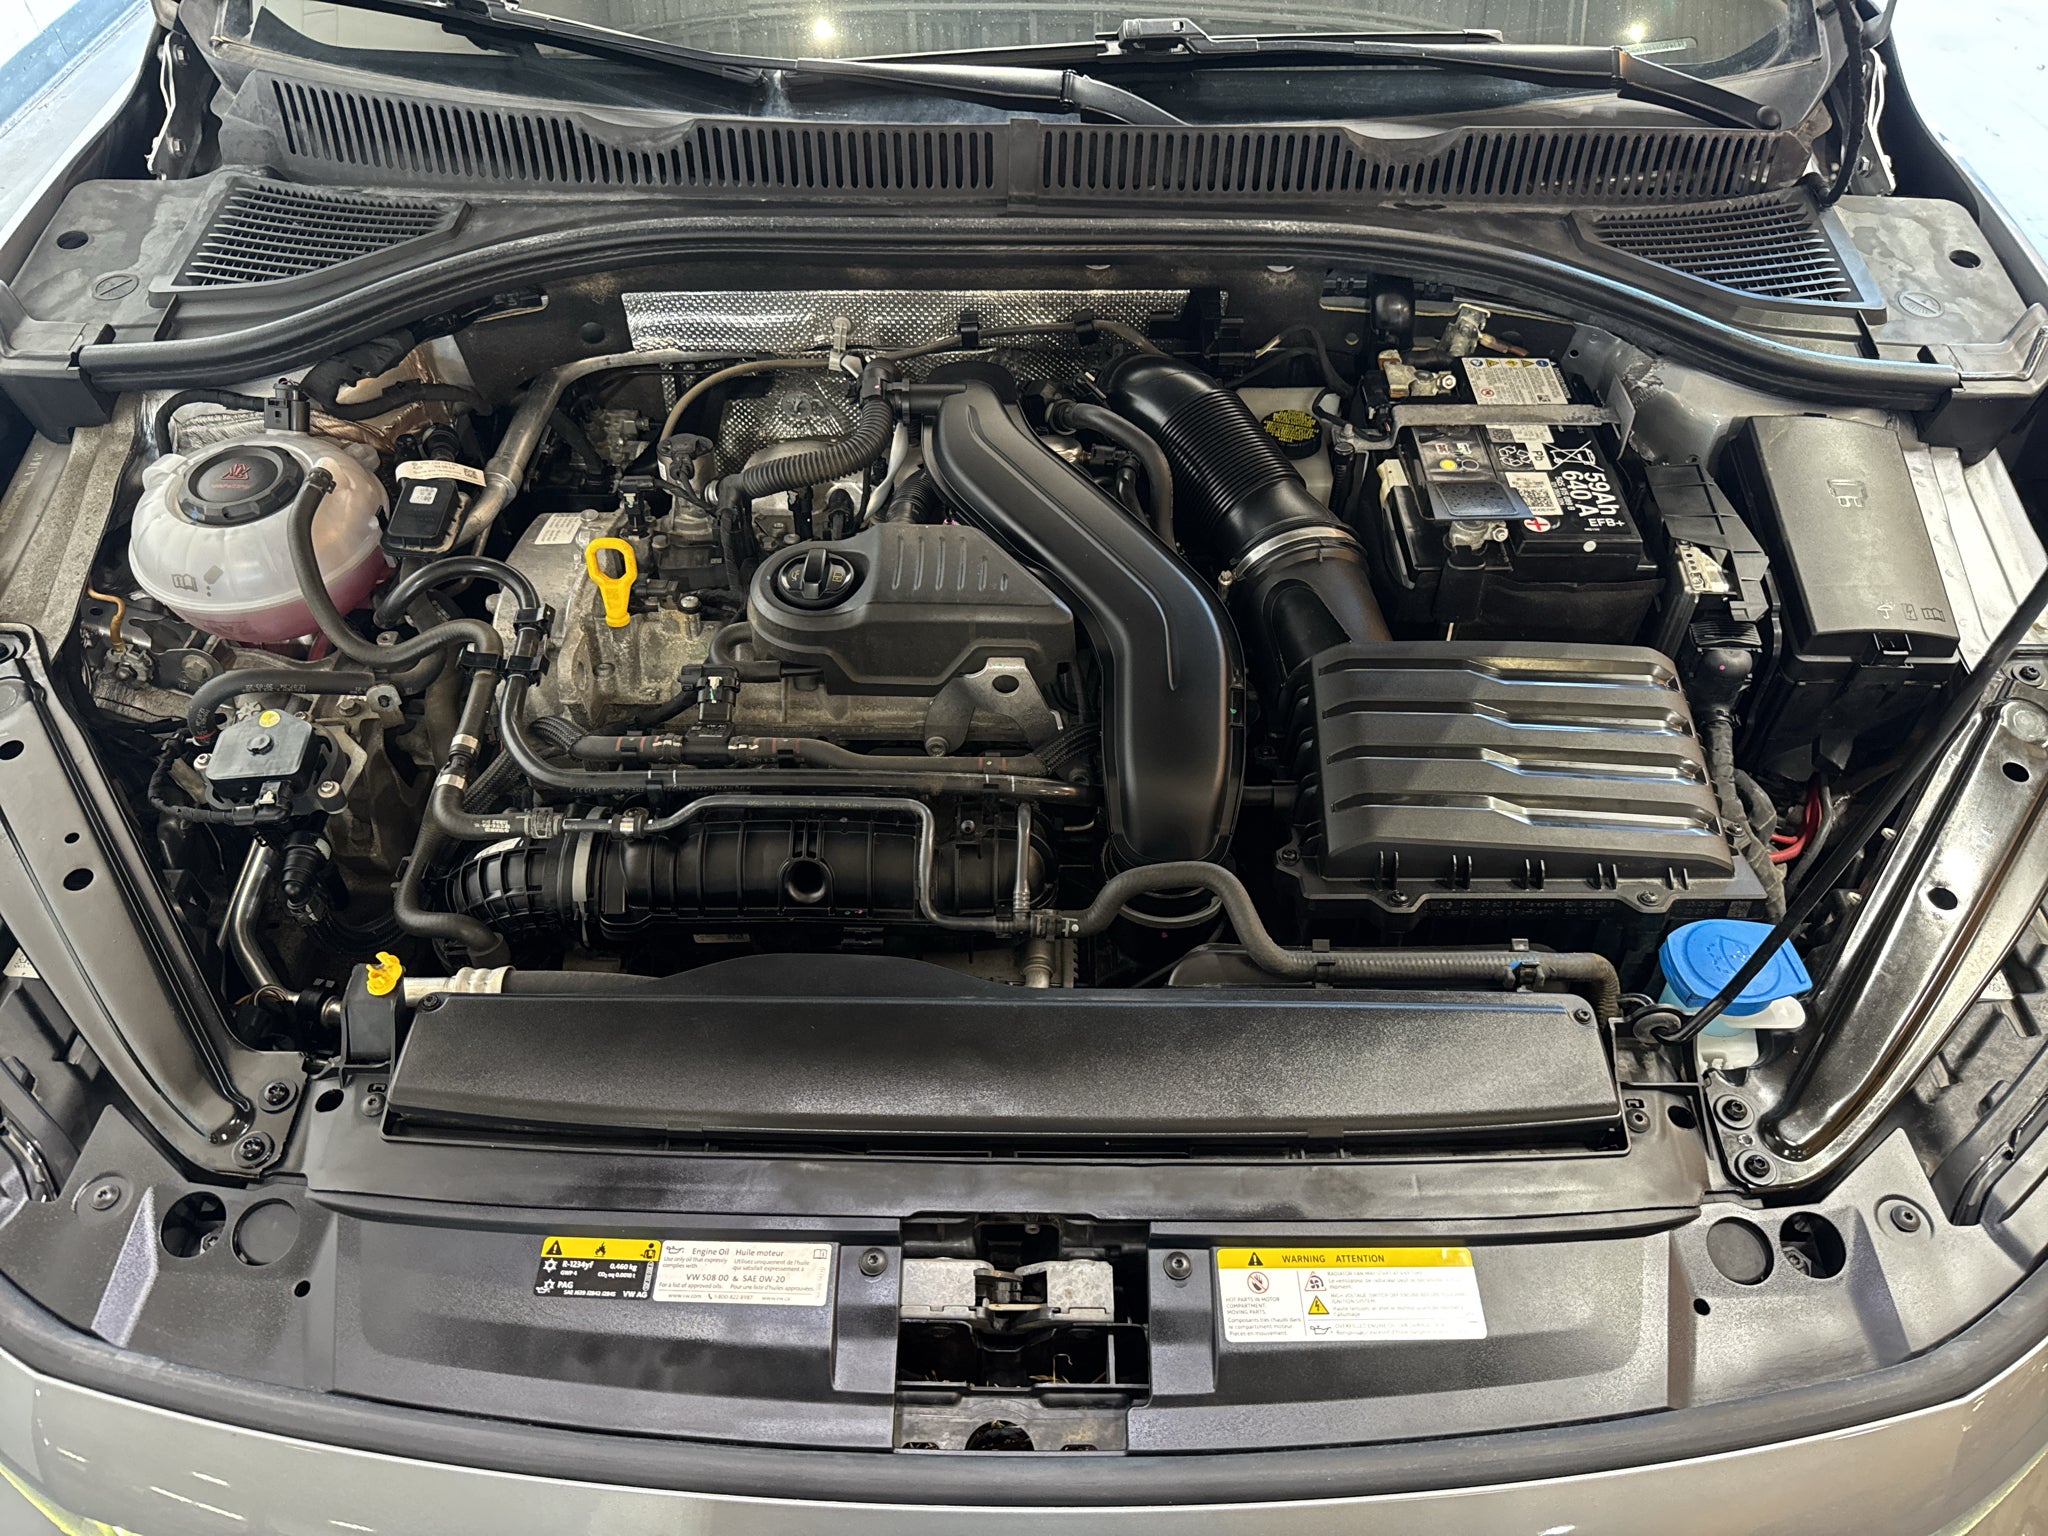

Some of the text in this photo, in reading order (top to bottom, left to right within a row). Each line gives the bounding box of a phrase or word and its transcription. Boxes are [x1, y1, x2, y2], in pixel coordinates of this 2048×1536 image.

[1562, 470, 1593, 500] 640
[1584, 472, 1620, 515] 59Ah
[1575, 503, 1600, 517] A
[1588, 518, 1625, 527] EFB+
[692, 1248, 718, 1257] Engine
[735, 1248, 784, 1257] Huile moteur
[1281, 1254, 1326, 1263] WARNING
[1336, 1254, 1385, 1263] ATTENTION
[562, 1260, 594, 1270] R-1234yf
[629, 1263, 637, 1271] kg
[758, 1275, 786, 1283] 0W-20
[557, 1280, 574, 1288] PAG
[687, 1282, 712, 1290] approved
[636, 1291, 648, 1299] AG
